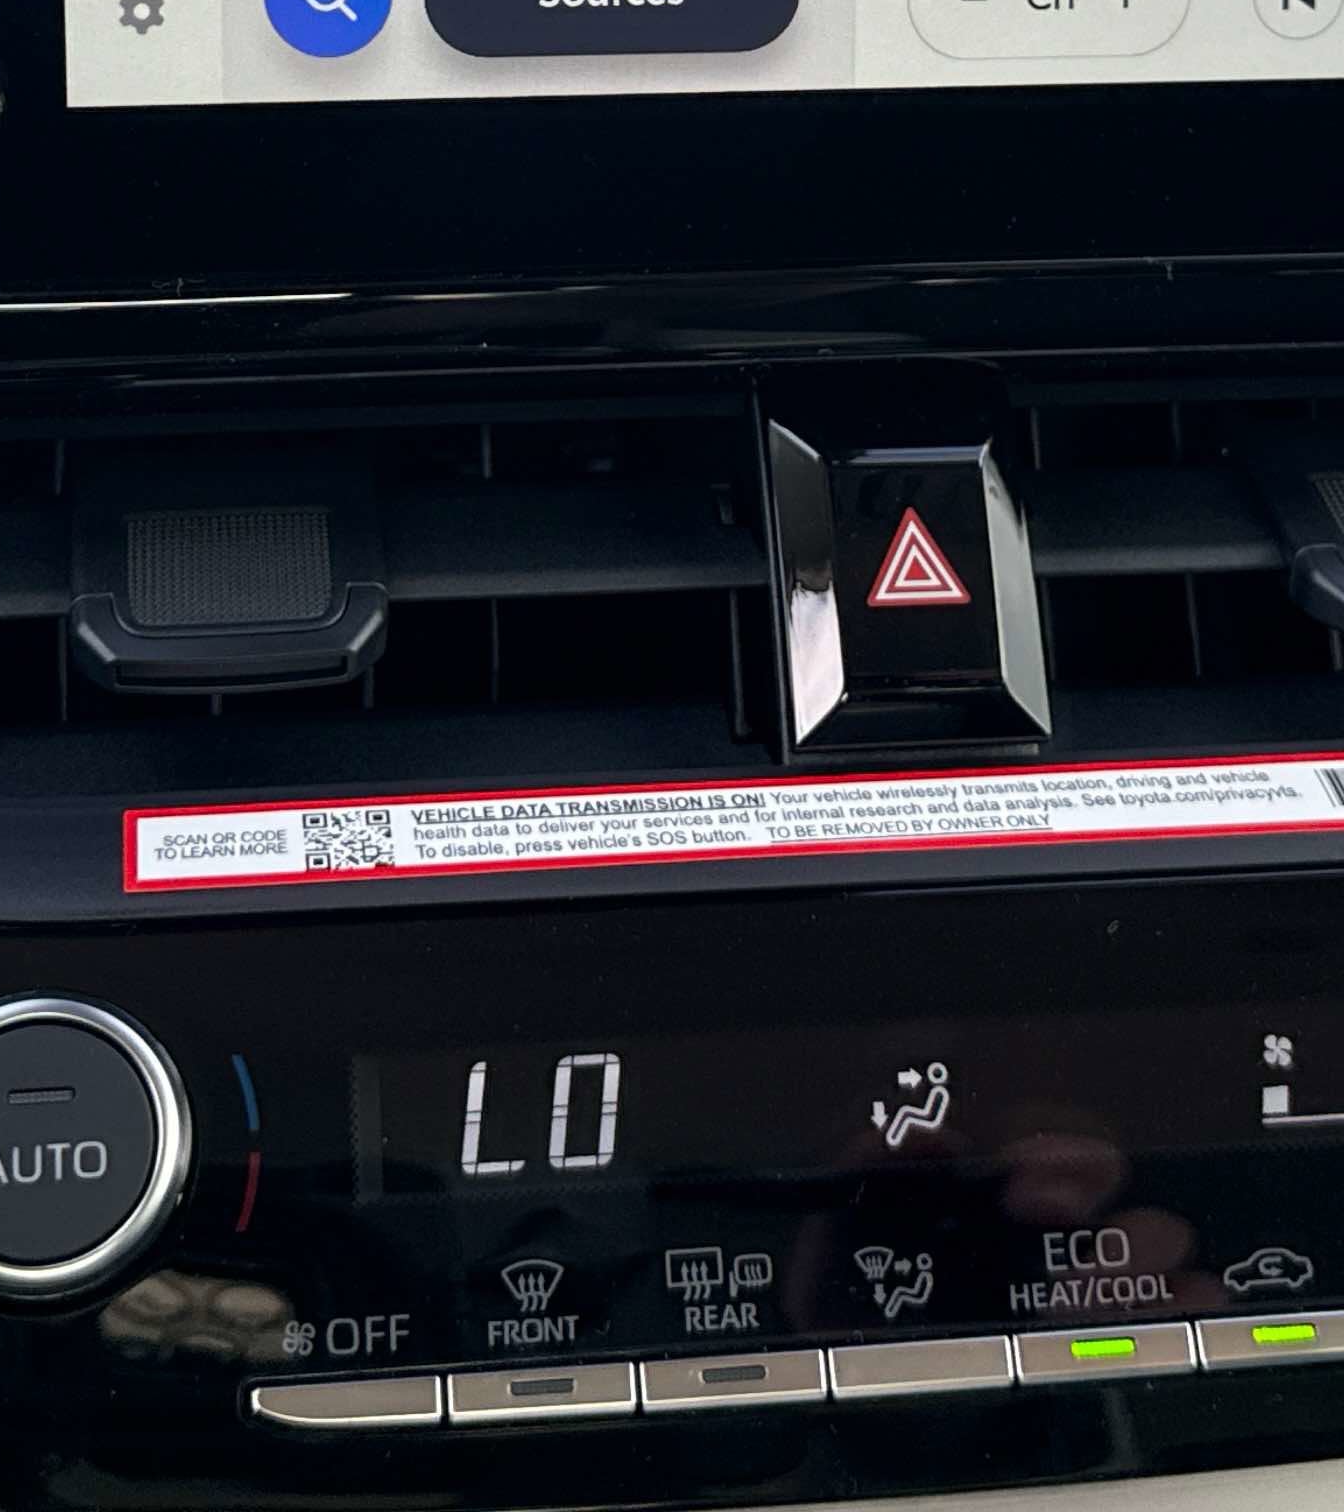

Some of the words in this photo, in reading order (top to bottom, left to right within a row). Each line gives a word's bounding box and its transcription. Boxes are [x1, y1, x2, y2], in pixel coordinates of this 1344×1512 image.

[411, 806, 494, 824] VEHICLE
[501, 802, 552, 820] DATA
[556, 795, 703, 816] TRANSMISSION
[709, 793, 726, 808] IS
[731, 791, 765, 808] ON!
[770, 790, 807, 805] Your
[813, 786, 872, 802] vehicle
[876, 783, 956, 800] wirelessly
[961, 779, 1038, 795] transmits
[1041, 776, 1112, 793] location,
[1116, 773, 1171, 789] driving
[1177, 771, 1207, 786] and
[1212, 768, 1269, 784] vehicle
[413, 824, 467, 841] health
[472, 820, 510, 838] data
[516, 819, 532, 835] to
[539, 816, 594, 833] deliver
[601, 819, 638, 836] your
[644, 812, 713, 828] services
[719, 809, 750, 825] and
[756, 808, 777, 823] for
[782, 805, 844, 821] internal
[849, 802, 922, 818] research
[927, 799, 957, 814] and
[963, 797, 1000, 813] data
[1006, 794, 1077, 811] analysis.
[1081, 791, 1116, 807] See
[155, 847, 177, 860] TO
[181, 845, 236, 859] LEARN
[240, 841, 288, 856] MORE
[162, 834, 208, 847] SCAN
[212, 832, 237, 845] QR
[241, 829, 287, 843] CODE
[416, 844, 436, 860] To
[442, 839, 509, 858] disable,
[515, 839, 563, 857] press
[568, 834, 642, 852] vehicle's
[647, 830, 687, 846] SOS
[692, 827, 752, 845] button.
[767, 826, 791, 840] TO
[795, 824, 817, 839] BE
[822, 819, 907, 837] REMOVED
[911, 817, 933, 833] BY
[938, 815, 1004, 831] OWNER
[1007, 813, 1050, 829] ONLY
[1043, 1229, 1131, 1271] ECO
[1009, 1274, 1174, 1311] HEAT/COOL
[326, 1314, 410, 1356] OFF
[488, 1314, 577, 1348] FRONT
[685, 1303, 760, 1332] REAR
